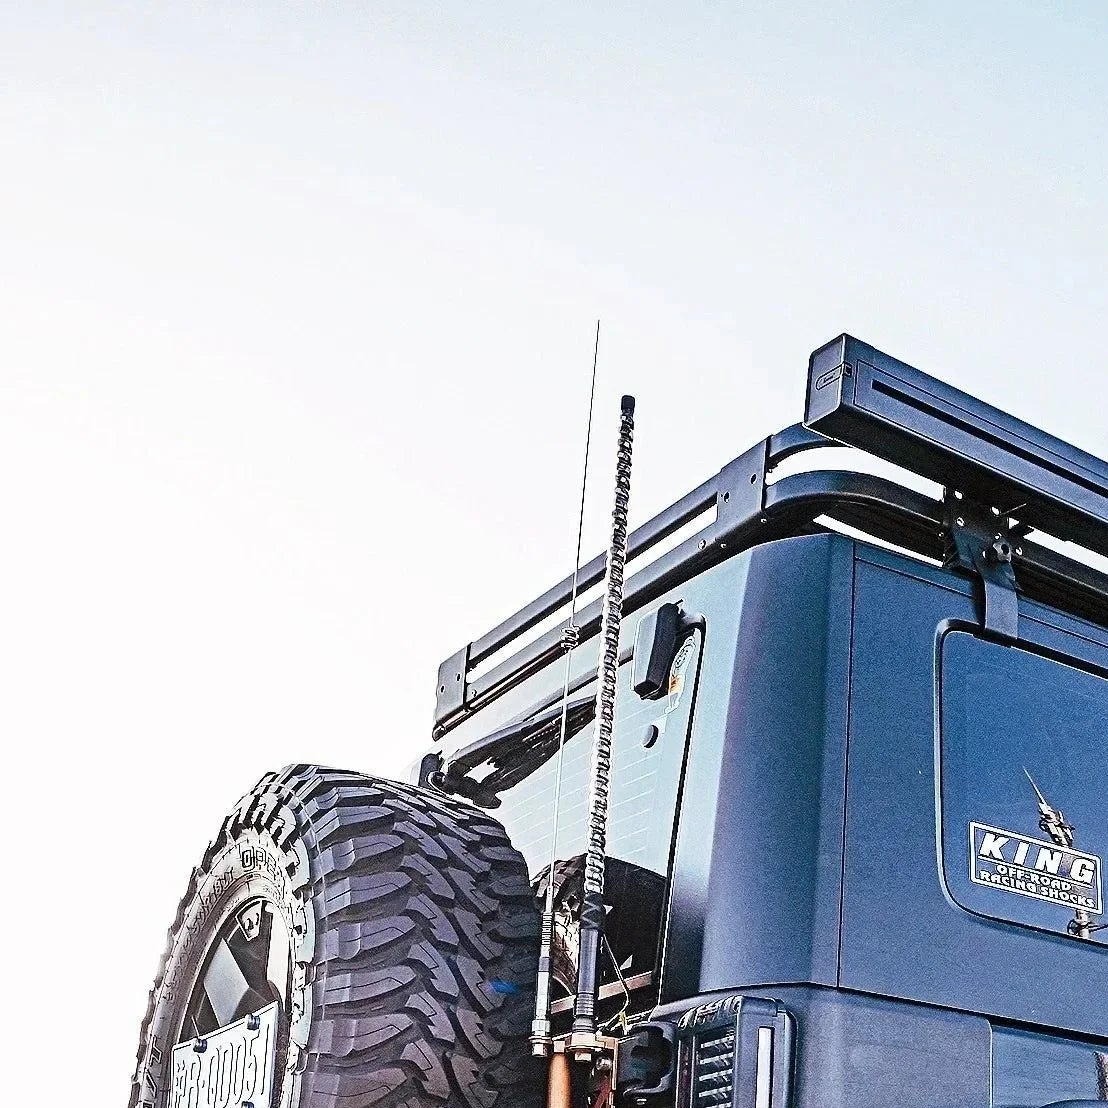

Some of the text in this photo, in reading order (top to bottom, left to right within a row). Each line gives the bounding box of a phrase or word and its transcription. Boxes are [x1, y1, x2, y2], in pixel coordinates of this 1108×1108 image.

[979, 832, 1095, 884] KING
[979, 870, 1096, 907] RACING SHOCKS
[996, 864, 1072, 892] OFF-ROAD
